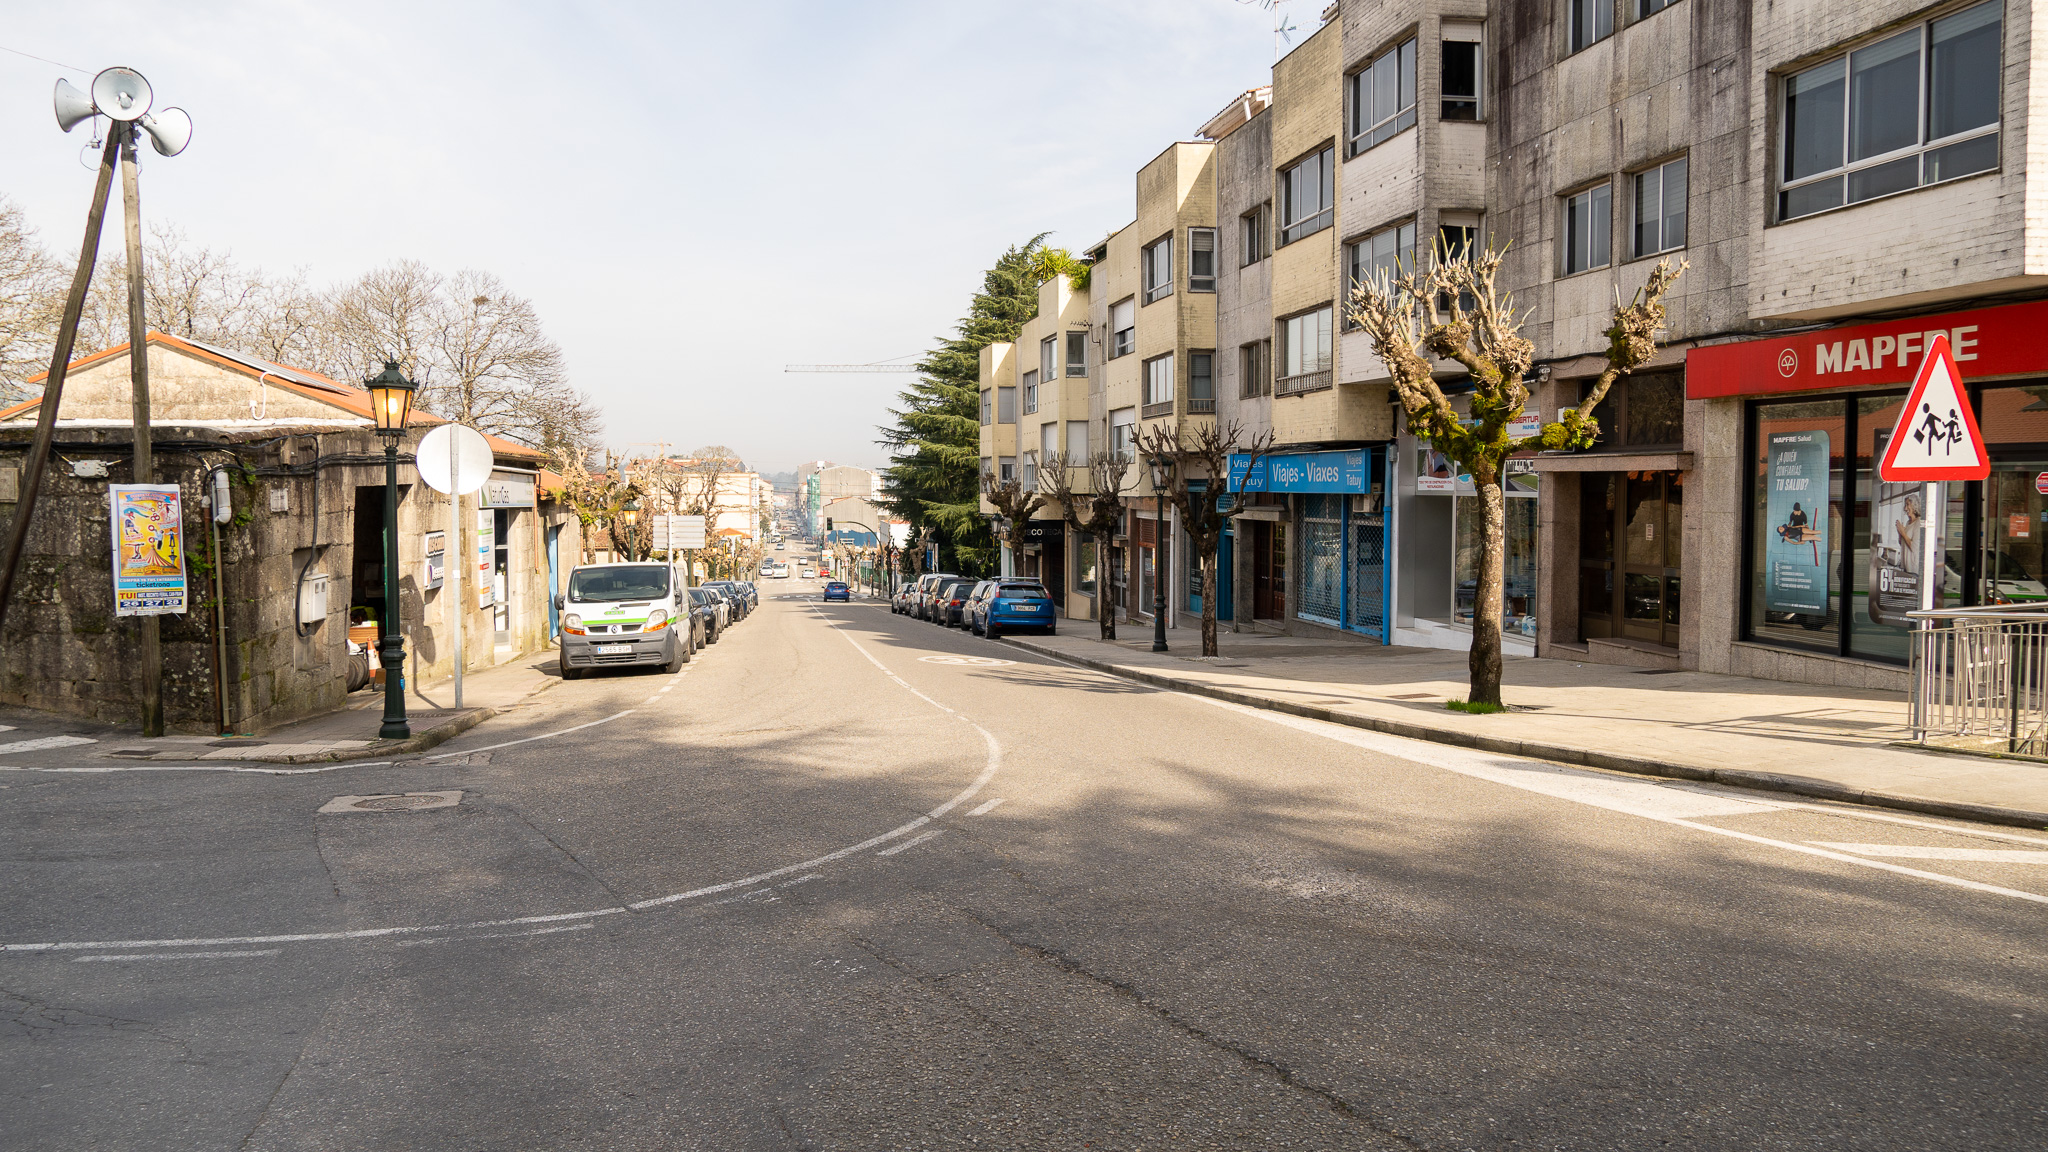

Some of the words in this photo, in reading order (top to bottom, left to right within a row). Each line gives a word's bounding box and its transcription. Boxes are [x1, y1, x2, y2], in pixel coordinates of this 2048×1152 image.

[1773, 435, 1797, 443] MAPFRE
[1346, 455, 1362, 467] Viajes
[1783, 449, 1797, 464] QUIÉN
[1273, 464, 1299, 487] Viajes
[1306, 462, 1339, 482] Viaxes
[1776, 463, 1802, 476] CONFIARÍAS
[1346, 474, 1362, 488] Tatuy
[1776, 479, 1784, 491] TU
[1784, 478, 1809, 491] SALUD?
